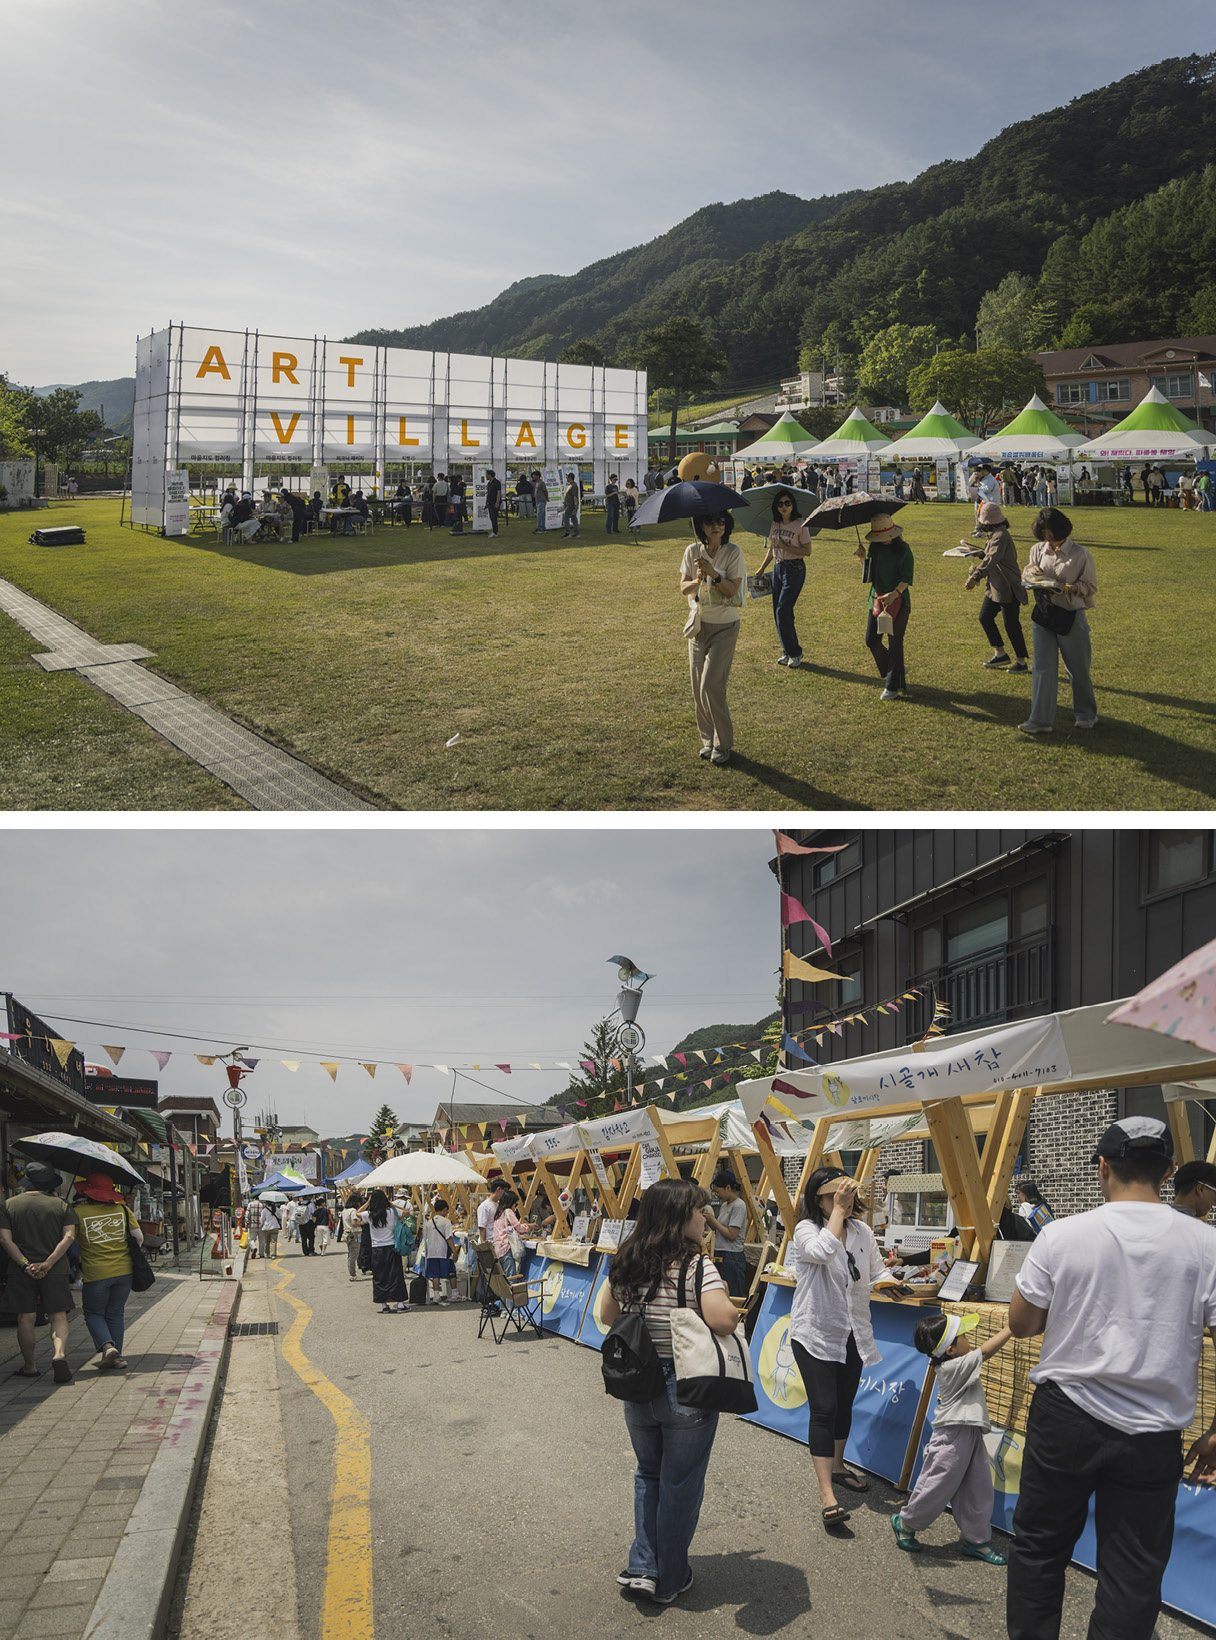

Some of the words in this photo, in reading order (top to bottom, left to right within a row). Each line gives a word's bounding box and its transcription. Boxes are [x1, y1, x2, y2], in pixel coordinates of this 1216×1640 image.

[196, 346, 364, 387] ART
[270, 411, 628, 448] VILLAGE
[992, 1064, 1057, 1085] 010-4011-7103
